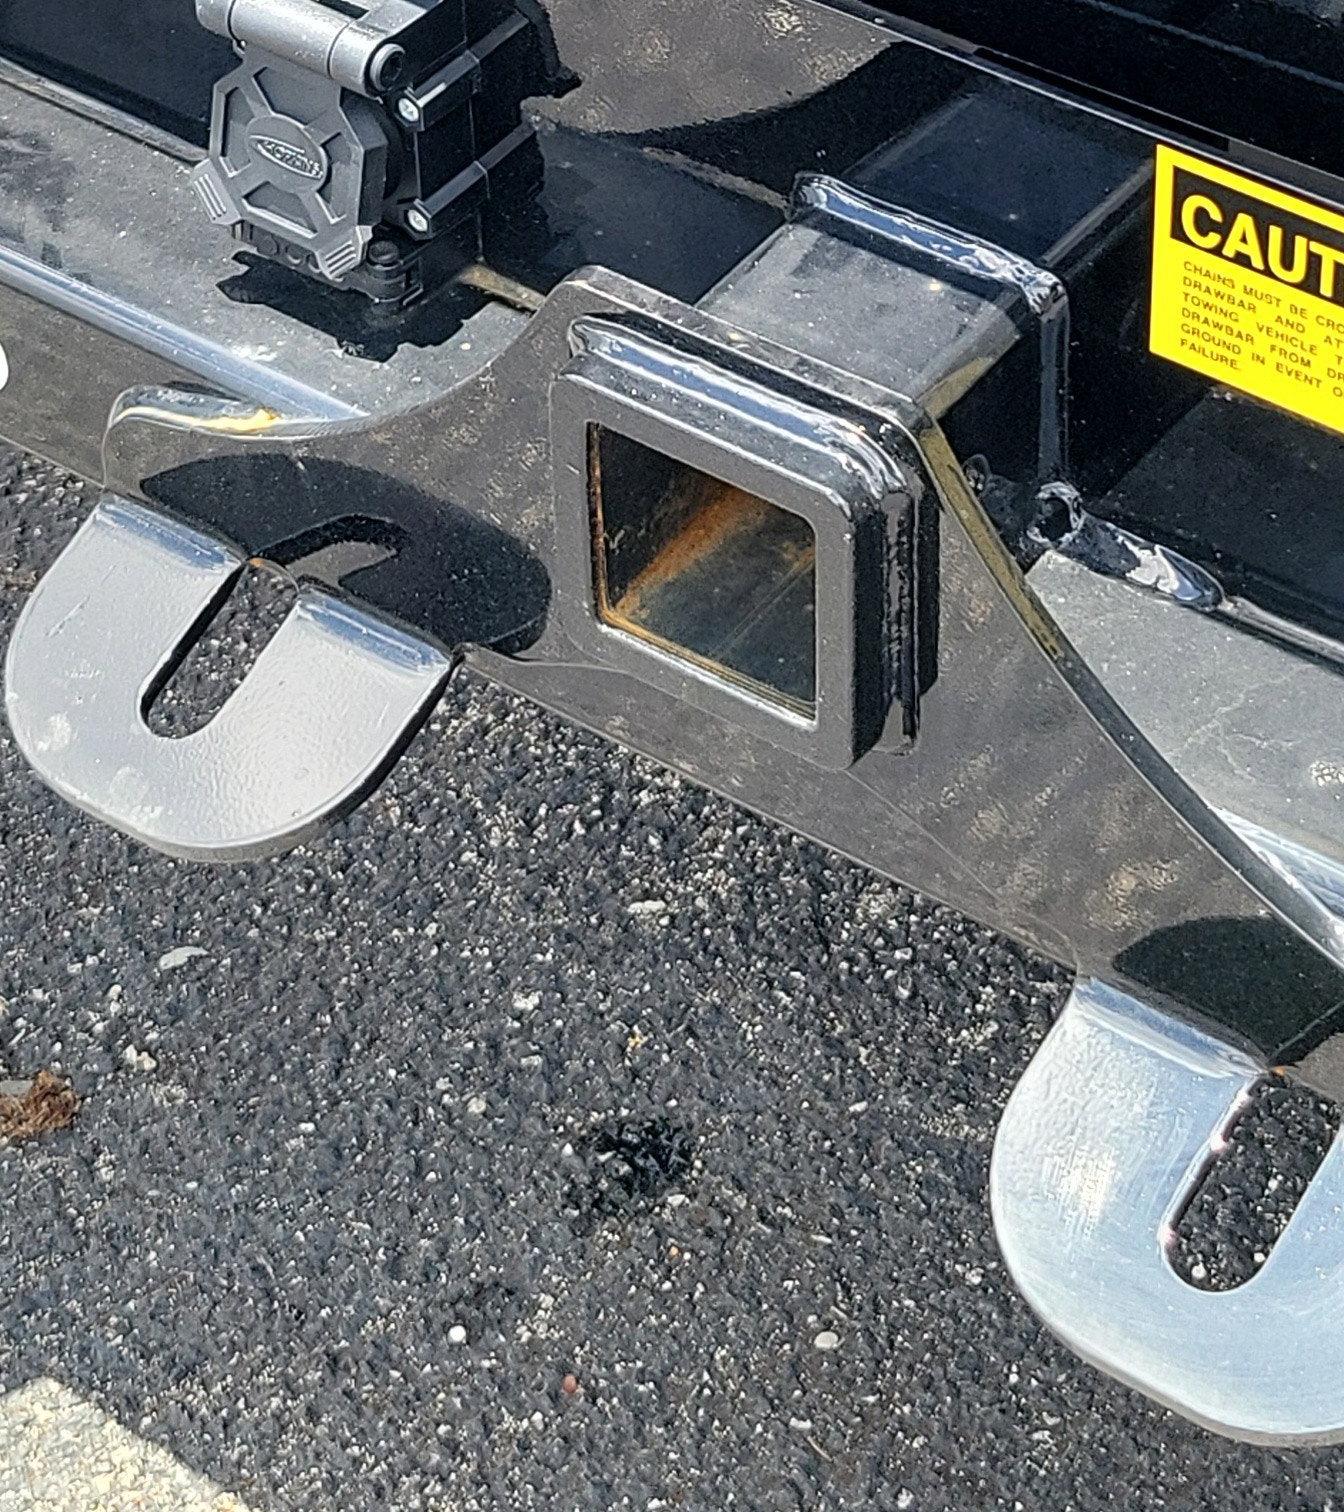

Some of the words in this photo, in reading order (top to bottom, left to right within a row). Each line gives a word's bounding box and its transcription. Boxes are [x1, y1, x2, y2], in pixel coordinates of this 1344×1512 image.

[1182, 275, 1256, 314] DRAWBAR
[1274, 313, 1305, 335] AND
[1183, 259, 1235, 290] CHAINS
[1243, 284, 1281, 309] MUST
[1289, 302, 1308, 320] BE
[1181, 290, 1238, 323] TOWING
[1255, 321, 1317, 356] VEHICLE
[1181, 306, 1254, 345] DRAWBAR
[1270, 343, 1311, 369] FROM
[1180, 321, 1240, 356] GROUND
[1251, 351, 1264, 366] IN
[1275, 361, 1322, 390] EVENT
